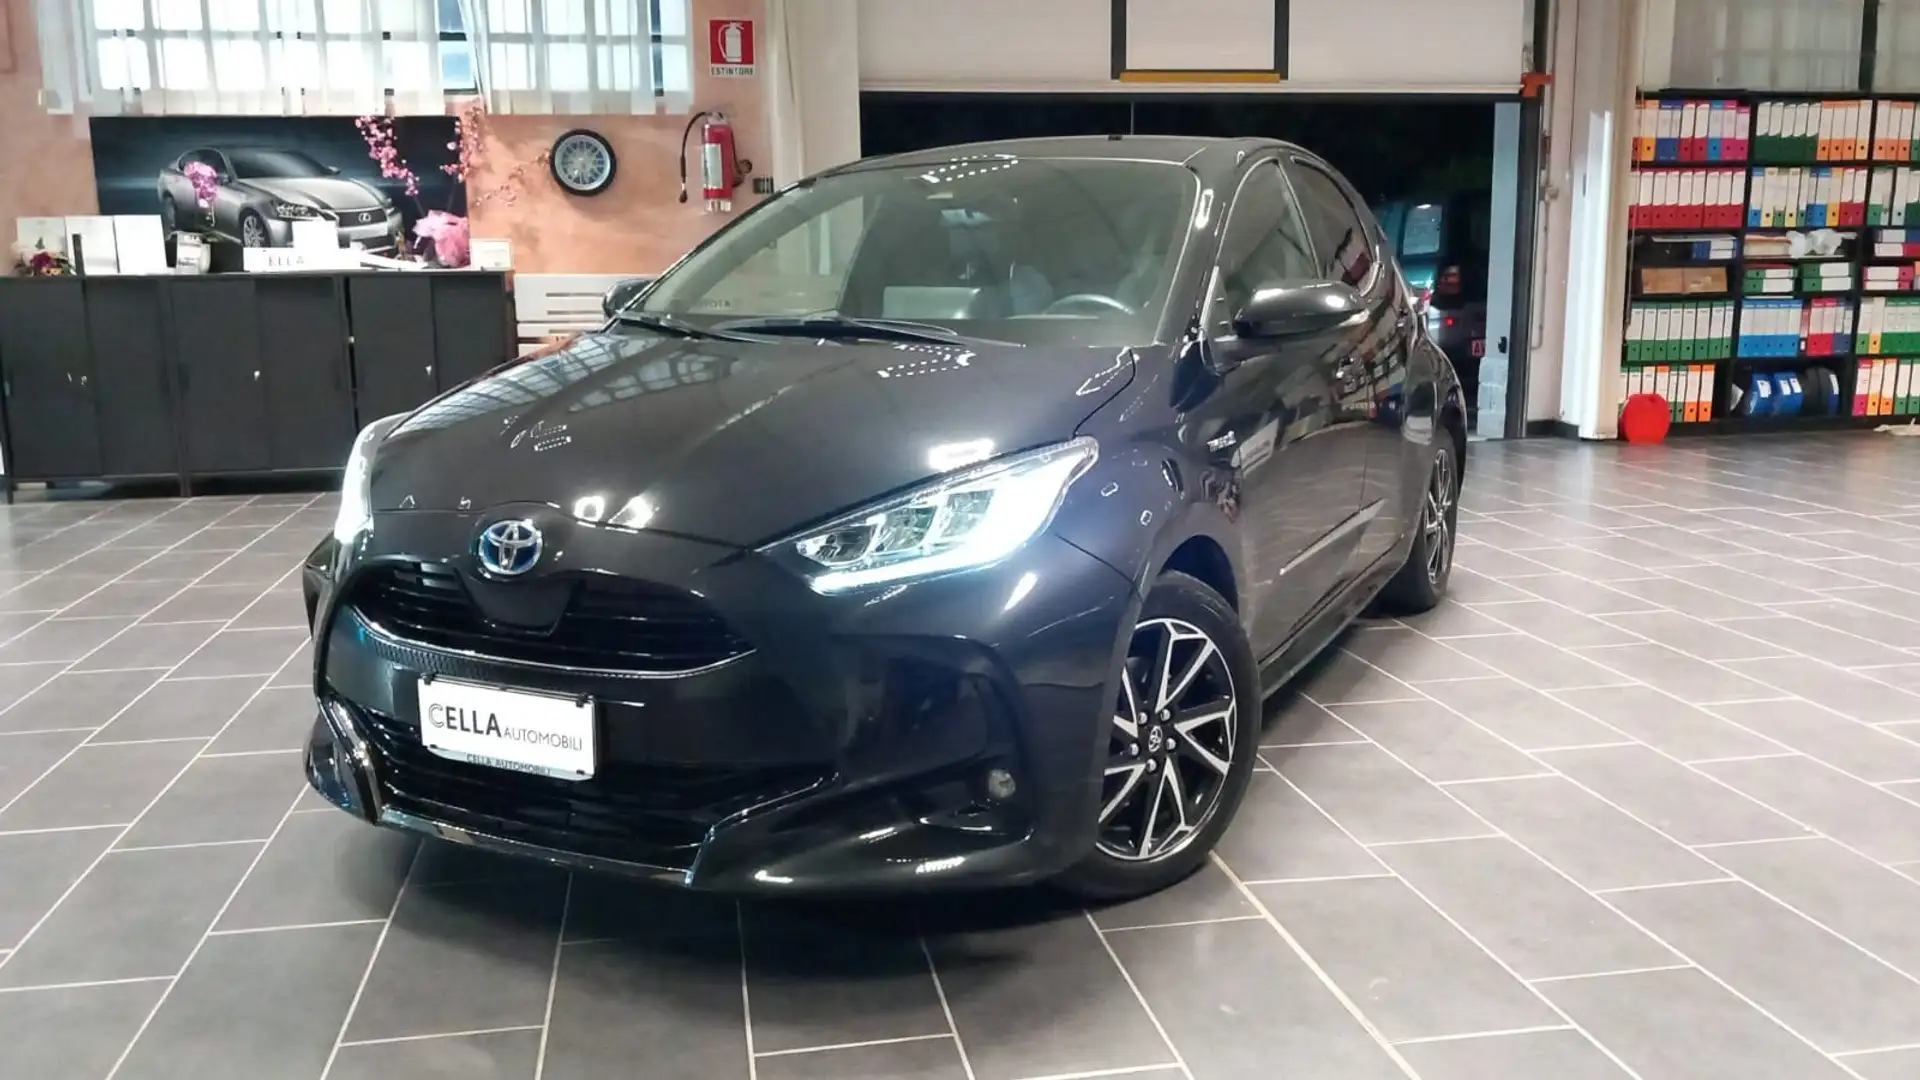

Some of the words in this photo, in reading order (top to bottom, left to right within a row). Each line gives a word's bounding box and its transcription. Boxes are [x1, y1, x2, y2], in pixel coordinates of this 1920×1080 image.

[711, 67, 753, 76] ESTINTORE
[428, 703, 502, 738] CELLA
[504, 727, 583, 751] AUTOMOBILI
[466, 753, 492, 767] CELLA
